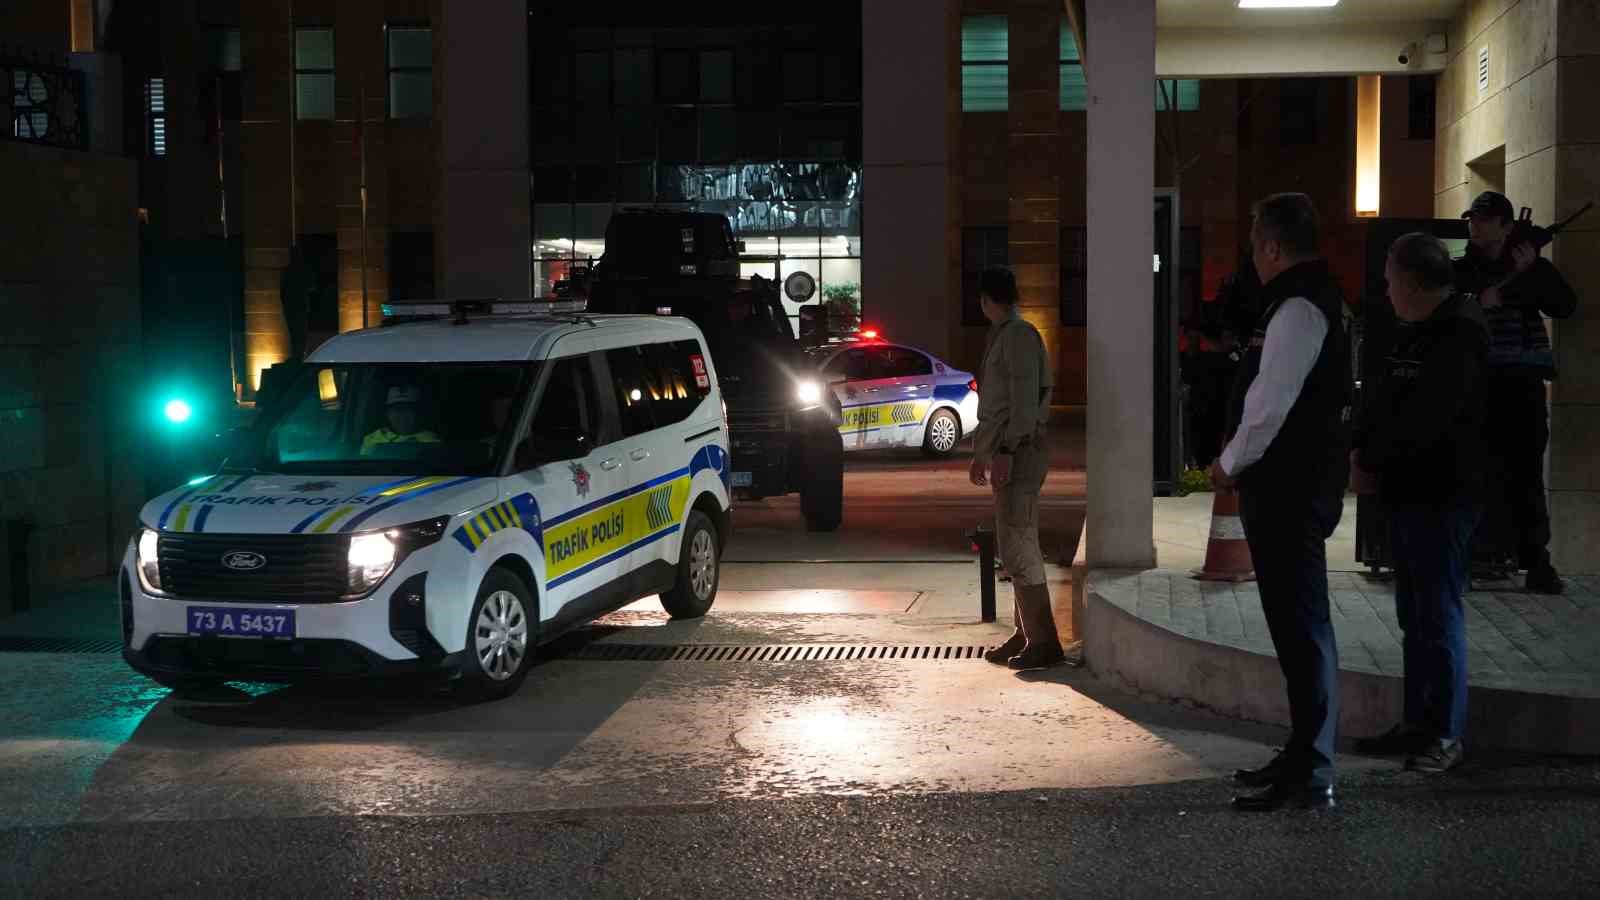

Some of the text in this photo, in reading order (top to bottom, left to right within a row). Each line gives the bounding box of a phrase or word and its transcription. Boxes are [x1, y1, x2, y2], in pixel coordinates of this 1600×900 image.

[550, 507, 624, 565] TRAFİK POLİSİ
[193, 612, 286, 632] 73 A 5437
